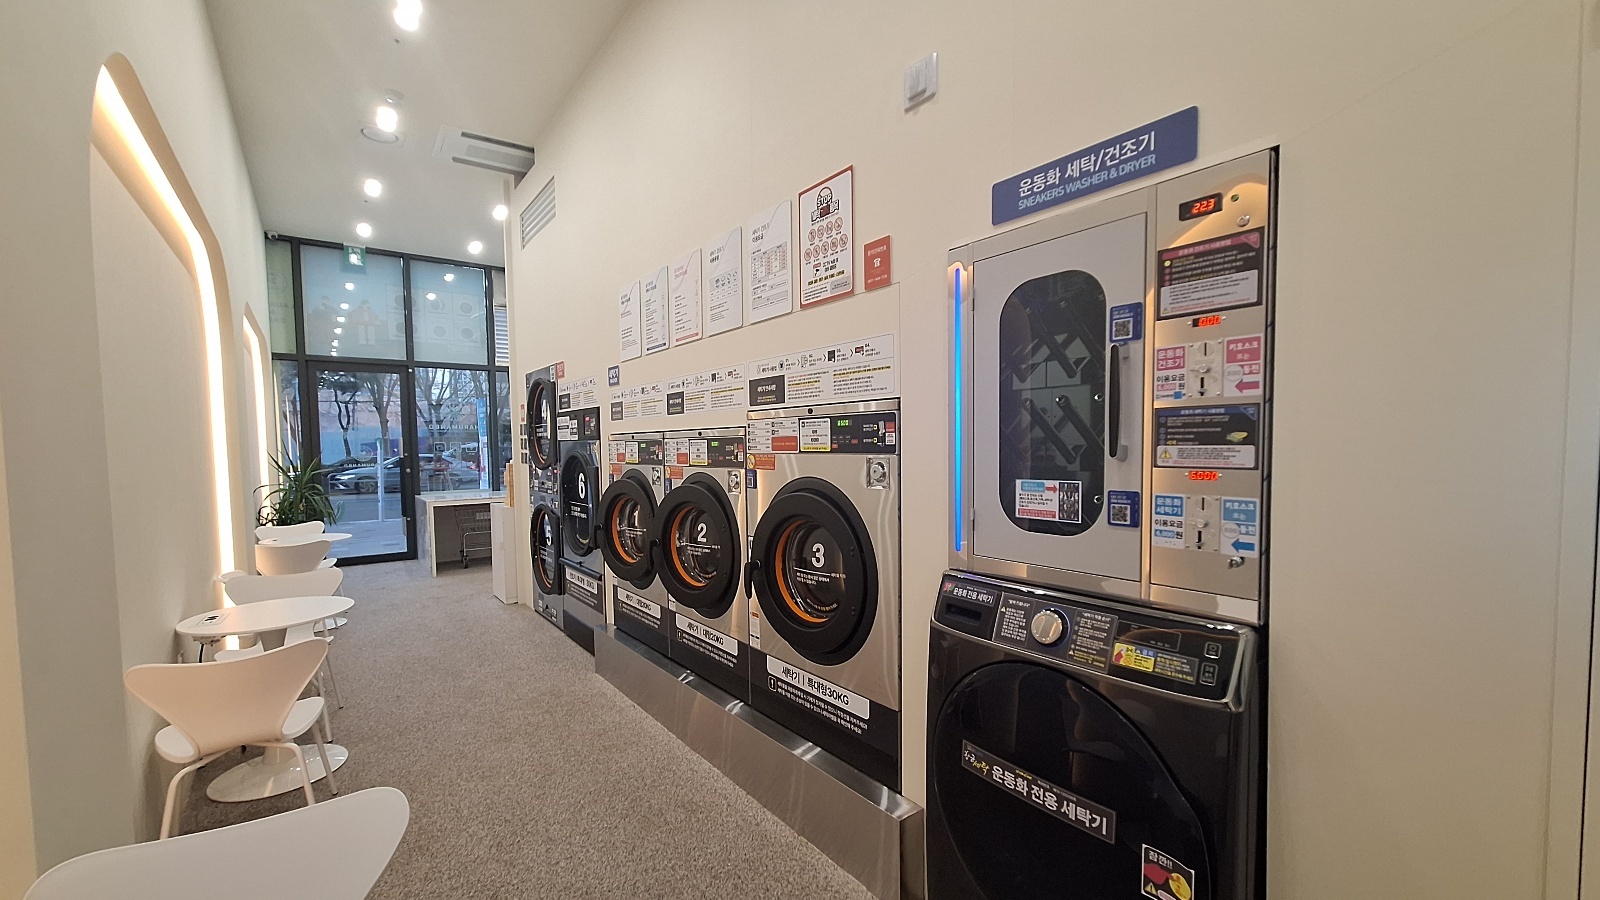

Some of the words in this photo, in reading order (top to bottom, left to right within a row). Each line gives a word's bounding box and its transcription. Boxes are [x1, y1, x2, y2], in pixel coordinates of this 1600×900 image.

[1018, 167, 1061, 197] 운동화
[1064, 131, 1155, 178] 세탁/건조기
[1018, 186, 1065, 210] SNEAKERS
[1066, 173, 1108, 195] WASHER
[1109, 168, 1118, 179] &
[1118, 153, 1156, 175] DRYER
[1158, 348, 1184, 359] 운동화
[1158, 358, 1184, 369] 건조기
[1156, 373, 1185, 383] 이용요금
[578, 472, 586, 499] 6
[1156, 497, 1181, 506] 운동화
[633, 510, 638, 527] 1
[1156, 506, 1181, 515] 세탁기
[1154, 518, 1184, 529] 이용요금
[1240, 525, 1256, 535] 동전
[546, 528, 552, 546] 5
[697, 522, 707, 543] 2
[811, 543, 825, 568] 3
[953, 587, 967, 598] 운동화
[967, 590, 978, 600] 전용
[977, 593, 993, 604] 세탁기
[782, 666, 800, 684] 세탁기
[807, 677, 850, 706] 특대형30KG
[992, 765, 1029, 796] 운동화
[1031, 784, 1058, 811] 전용
[1061, 800, 1107, 836] 세탁기
